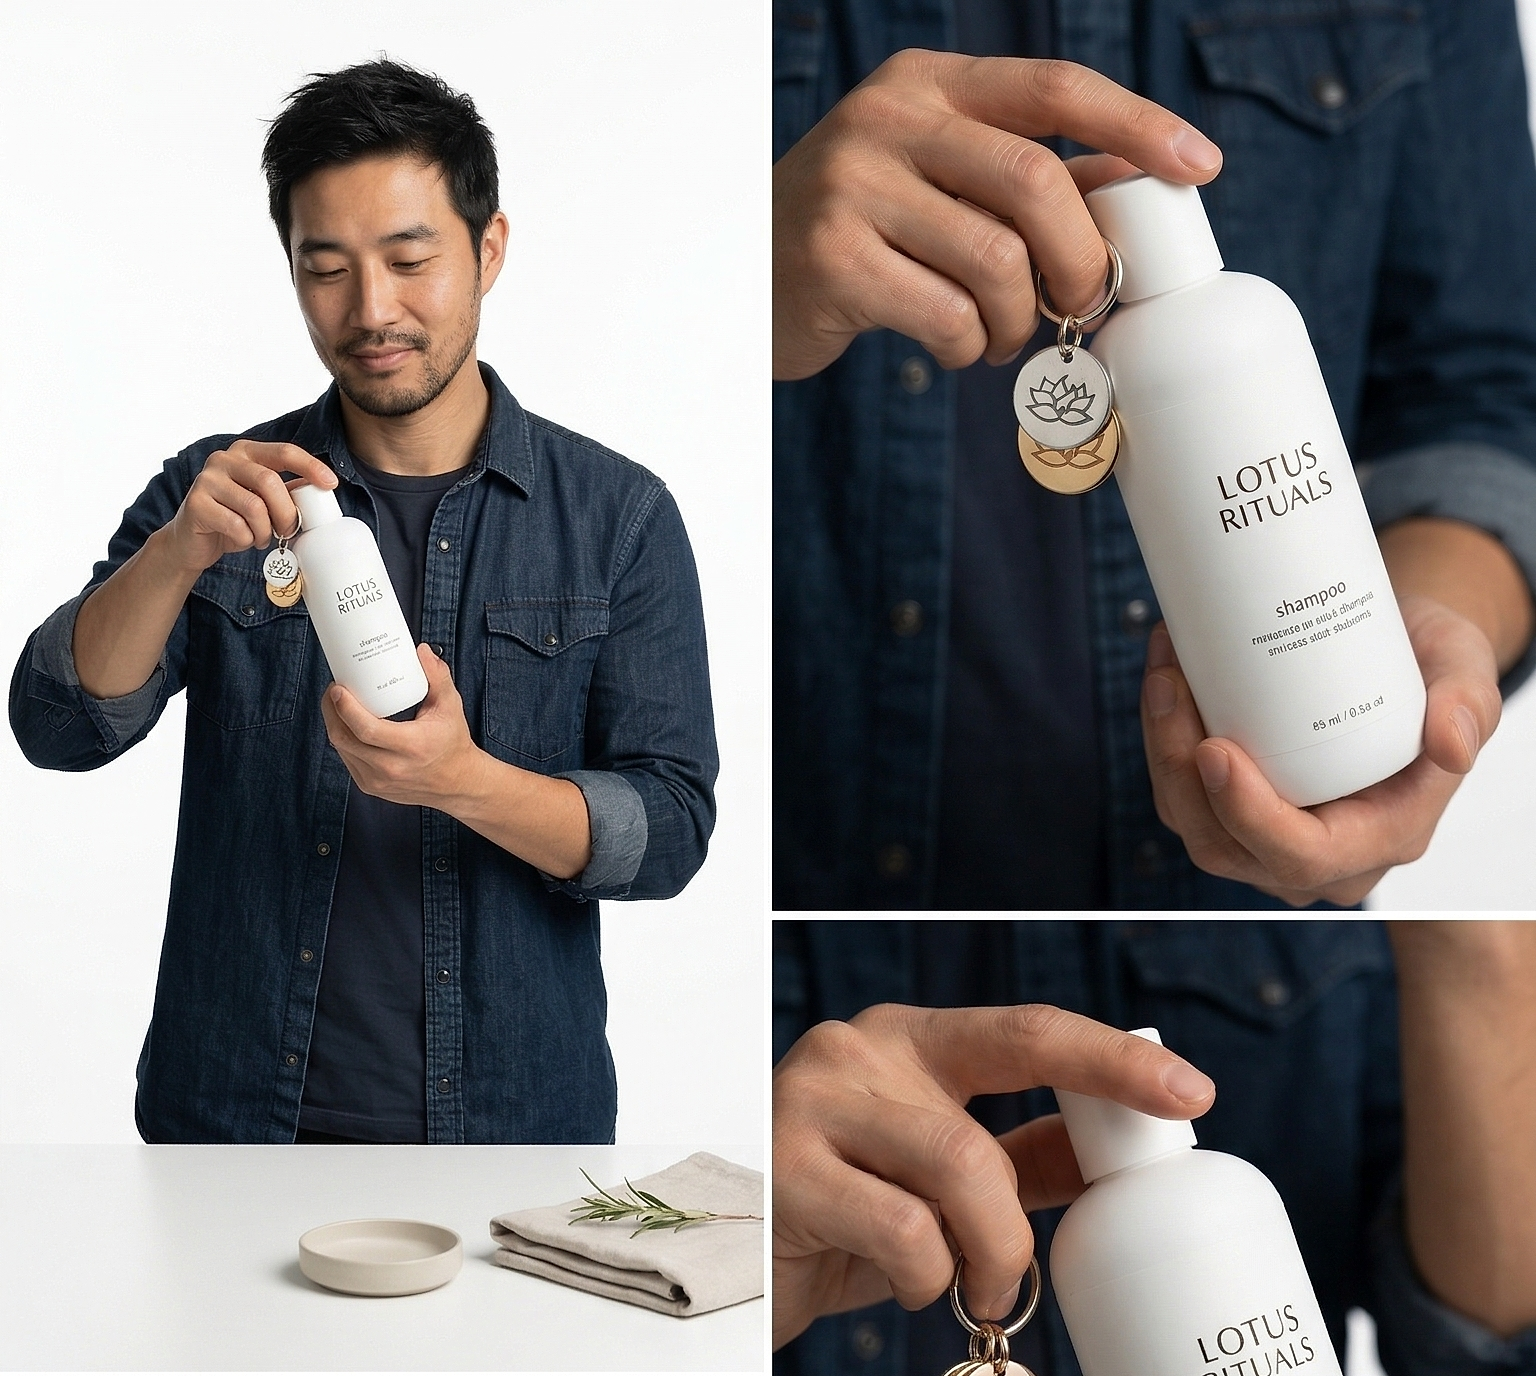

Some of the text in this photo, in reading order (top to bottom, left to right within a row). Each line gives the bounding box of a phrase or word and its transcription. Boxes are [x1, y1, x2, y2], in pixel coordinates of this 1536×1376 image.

[1217, 442, 1317, 500] LOTUS
[1218, 471, 1333, 533] RITUALS
[336, 578, 377, 602] LOTUS
[1275, 581, 1347, 619] shampoo
[1328, 713, 1341, 728] ml
[1197, 1304, 1299, 1364] LOTUS
